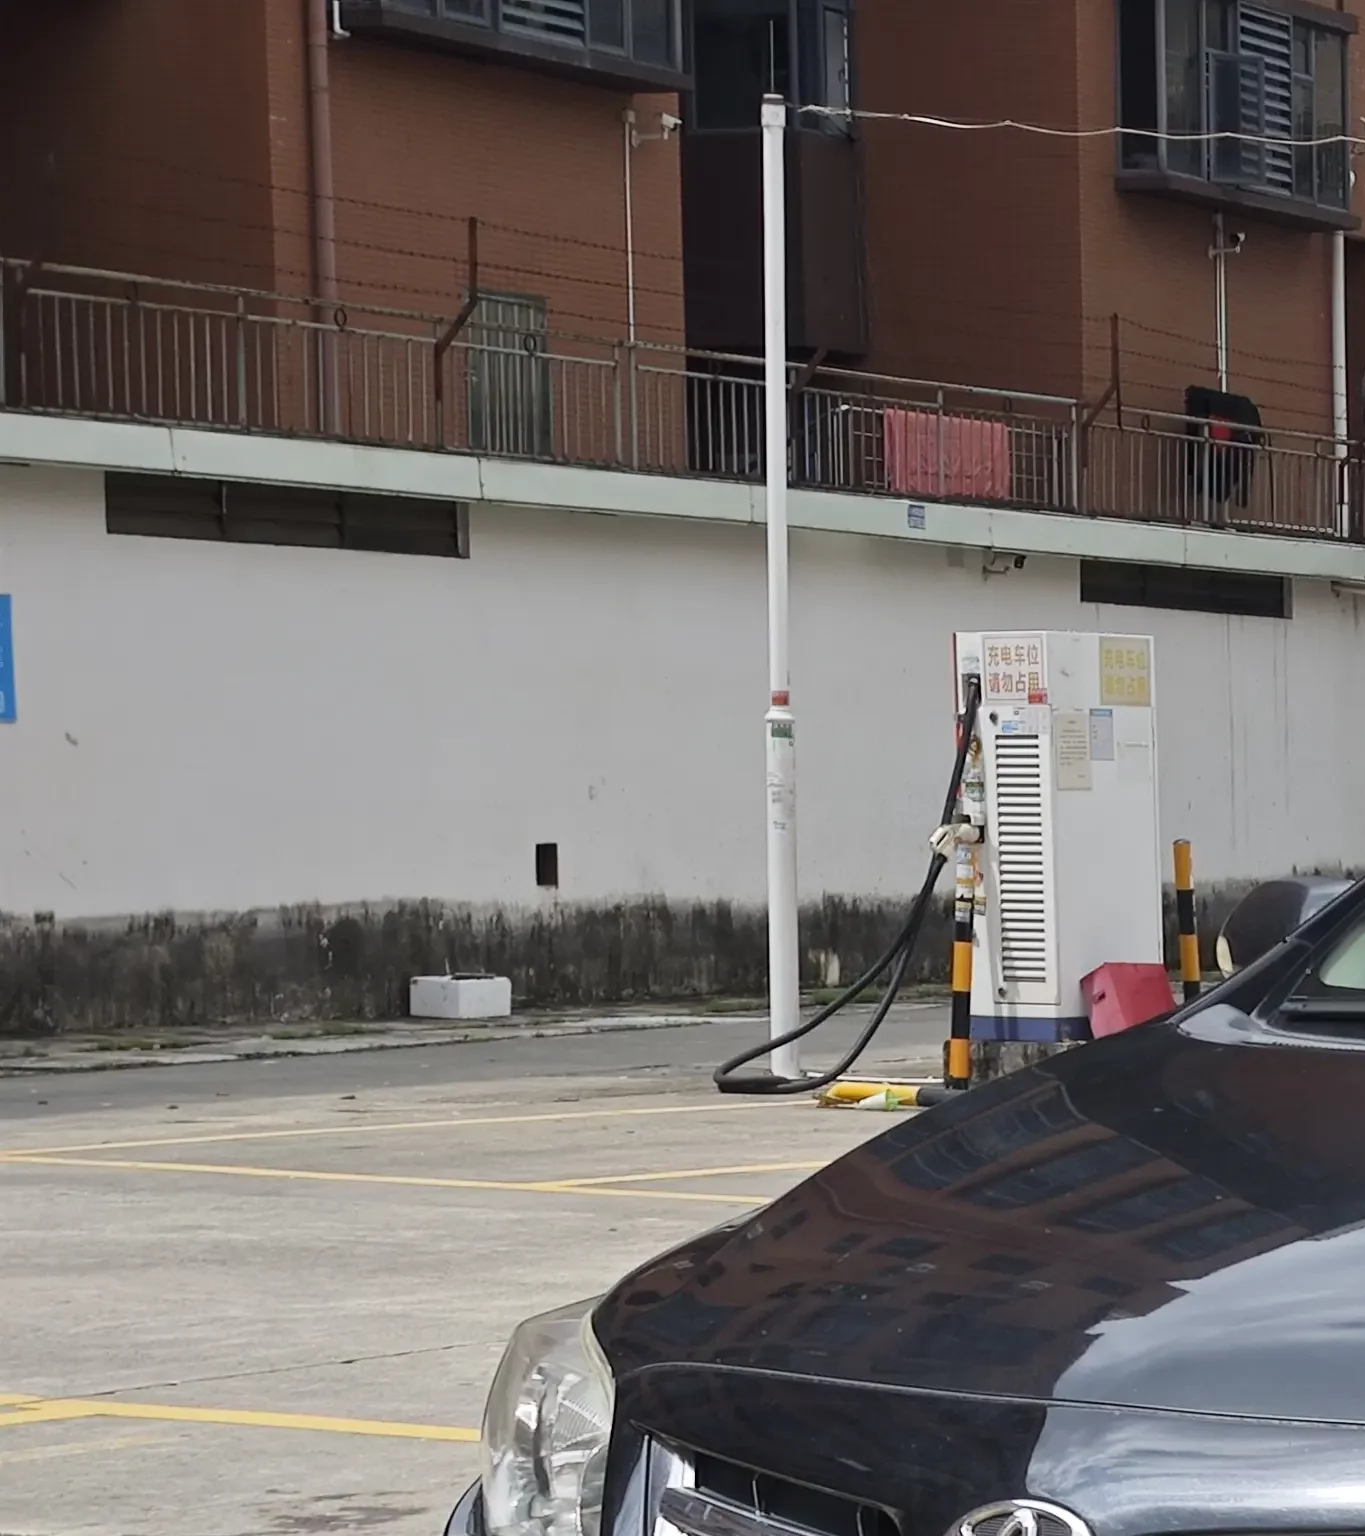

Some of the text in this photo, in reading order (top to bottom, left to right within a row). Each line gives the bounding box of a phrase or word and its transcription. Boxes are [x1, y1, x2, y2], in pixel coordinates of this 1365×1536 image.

[987, 644, 1040, 667] 充电车位
[988, 671, 1040, 694] 请勿占用
